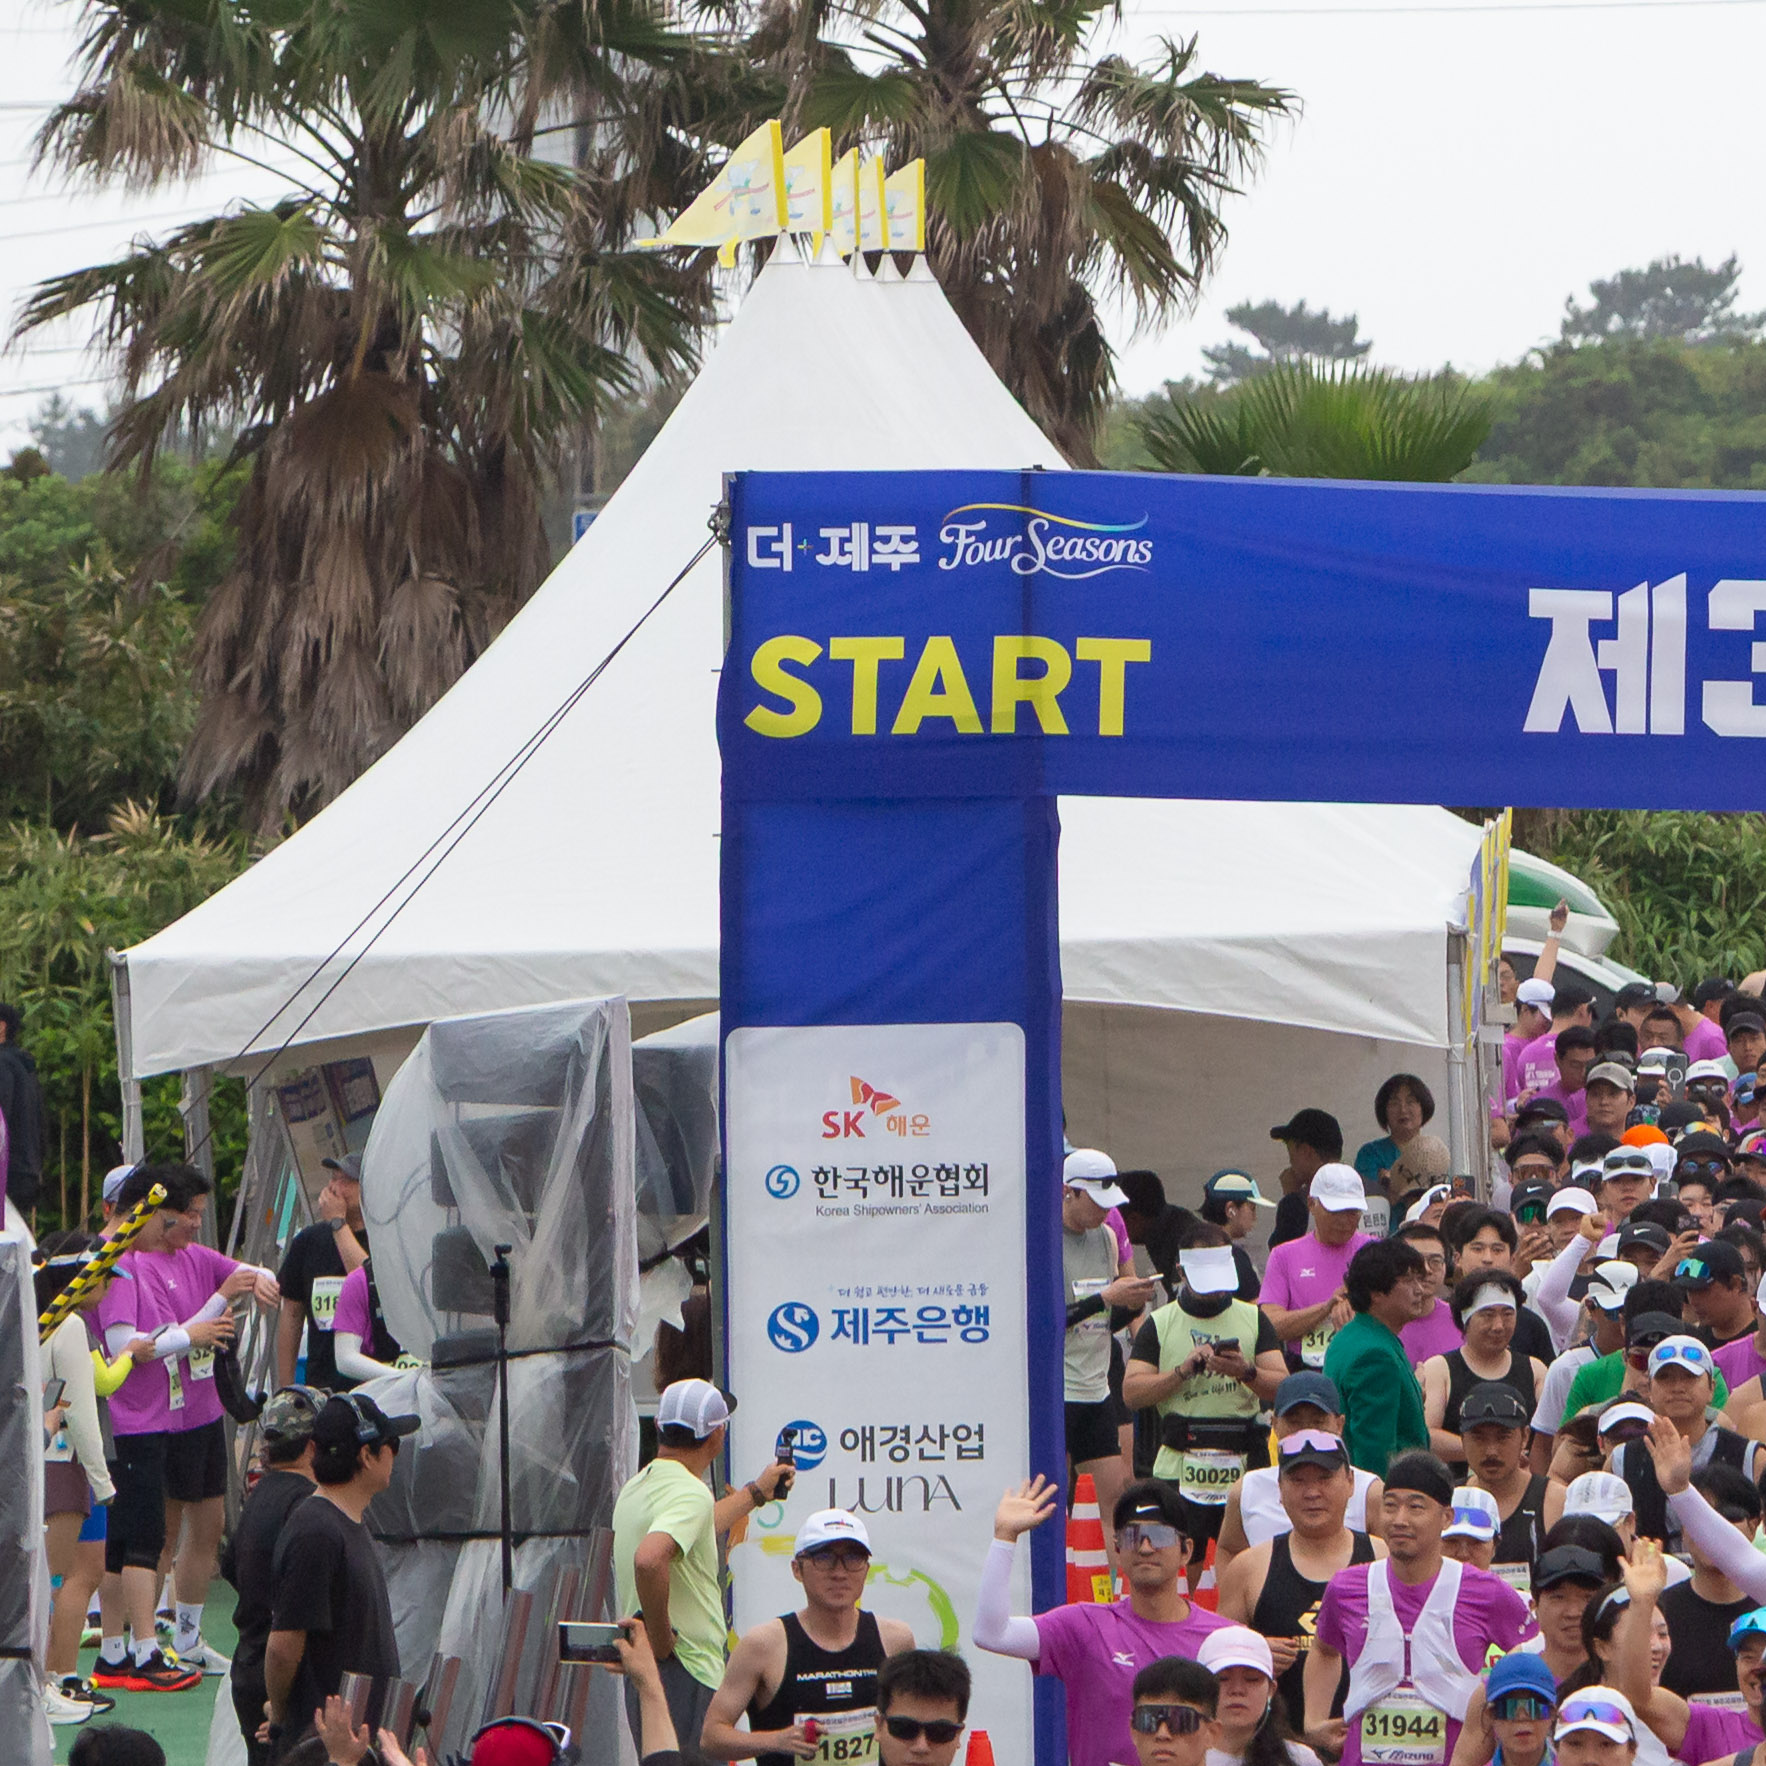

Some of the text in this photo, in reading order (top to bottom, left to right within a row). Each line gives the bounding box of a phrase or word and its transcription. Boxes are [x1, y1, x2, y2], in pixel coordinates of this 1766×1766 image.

[747, 521, 920, 573] 더 제주
[939, 515, 1152, 577] Four Seasons
[743, 635, 1152, 738] START
[821, 1110, 866, 1139] SK
[811, 1162, 989, 1199] 한국해운협회
[815, 1204, 850, 1217] Korea
[830, 1304, 991, 1347] 제주은행
[840, 1422, 985, 1461] 애경산업
[1186, 1465, 1240, 1484] 30029
[1366, 1713, 1440, 1739] 31944
